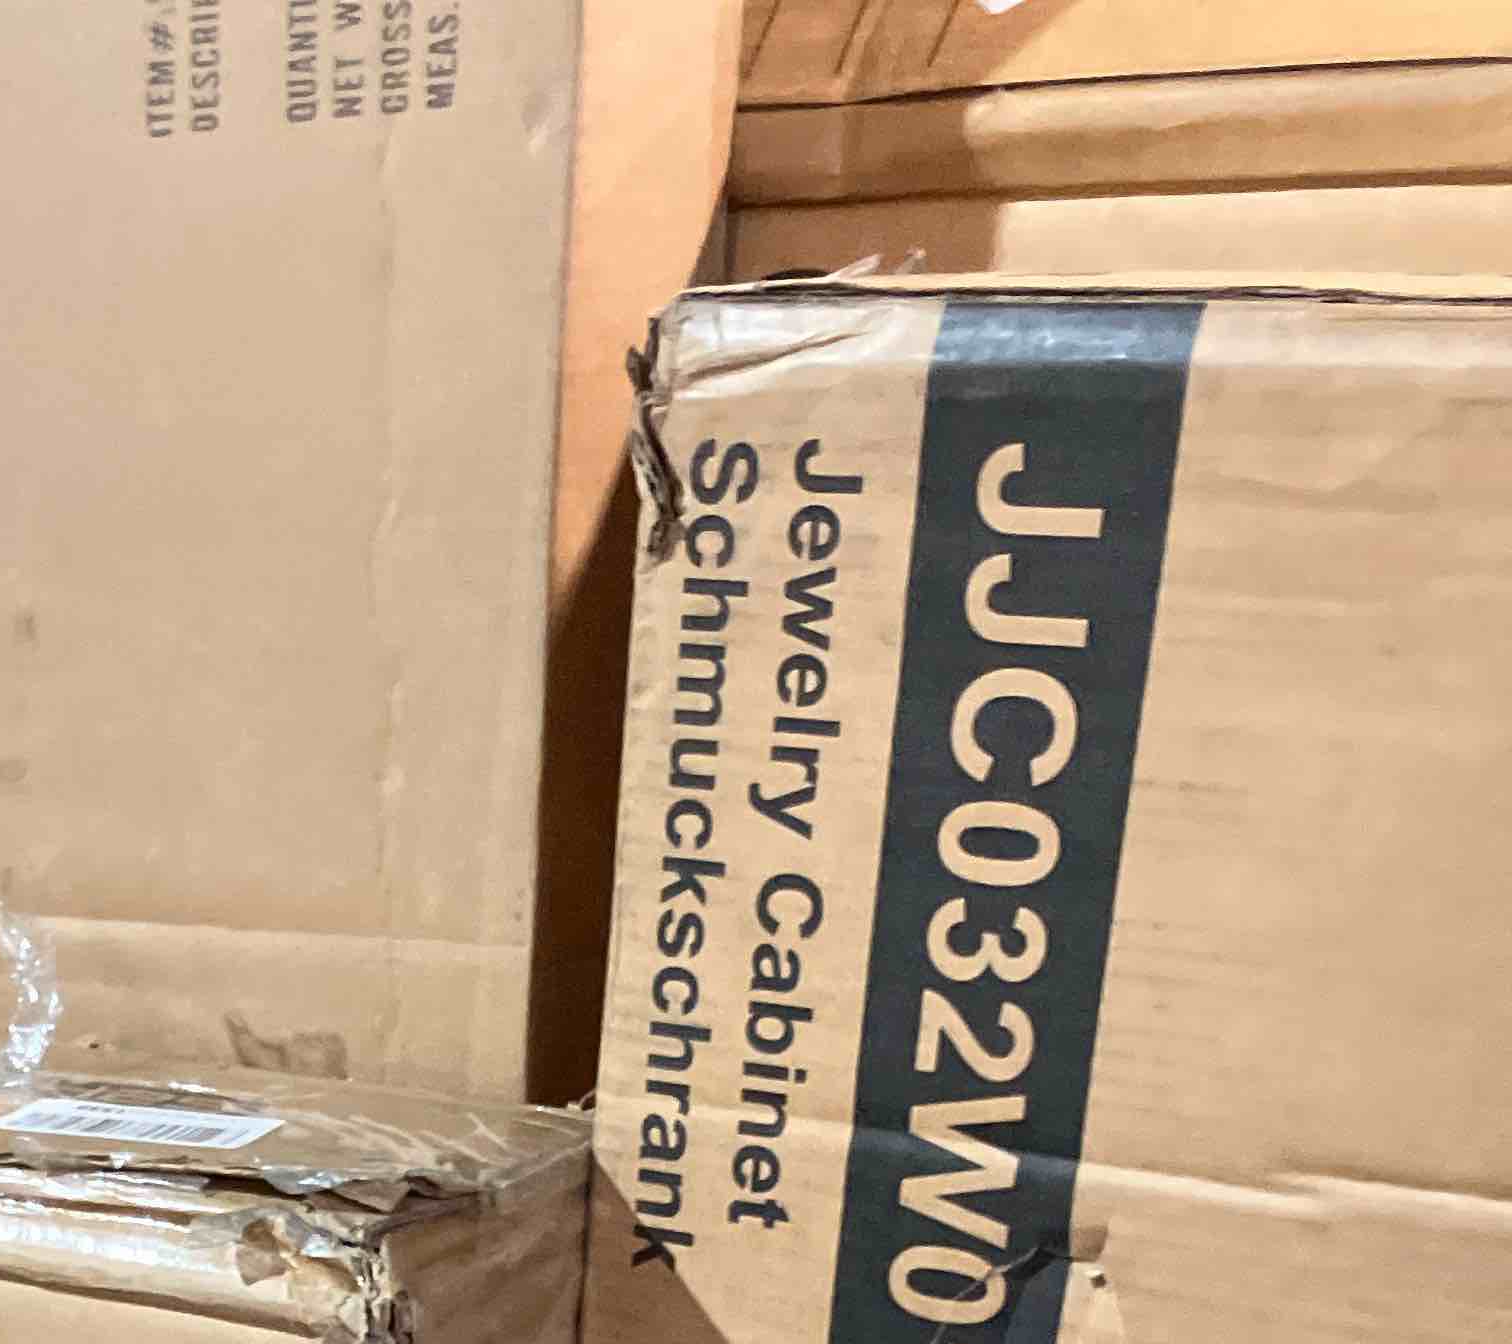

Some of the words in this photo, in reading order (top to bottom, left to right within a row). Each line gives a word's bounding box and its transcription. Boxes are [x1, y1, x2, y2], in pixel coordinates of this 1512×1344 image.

[334, 58, 363, 118] NET
[380, 0, 411, 114] GROSS
[748, 438, 863, 840] Jewelry
[631, 438, 759, 1272] Schmuckschrank
[727, 872, 824, 1229] Cabinet
